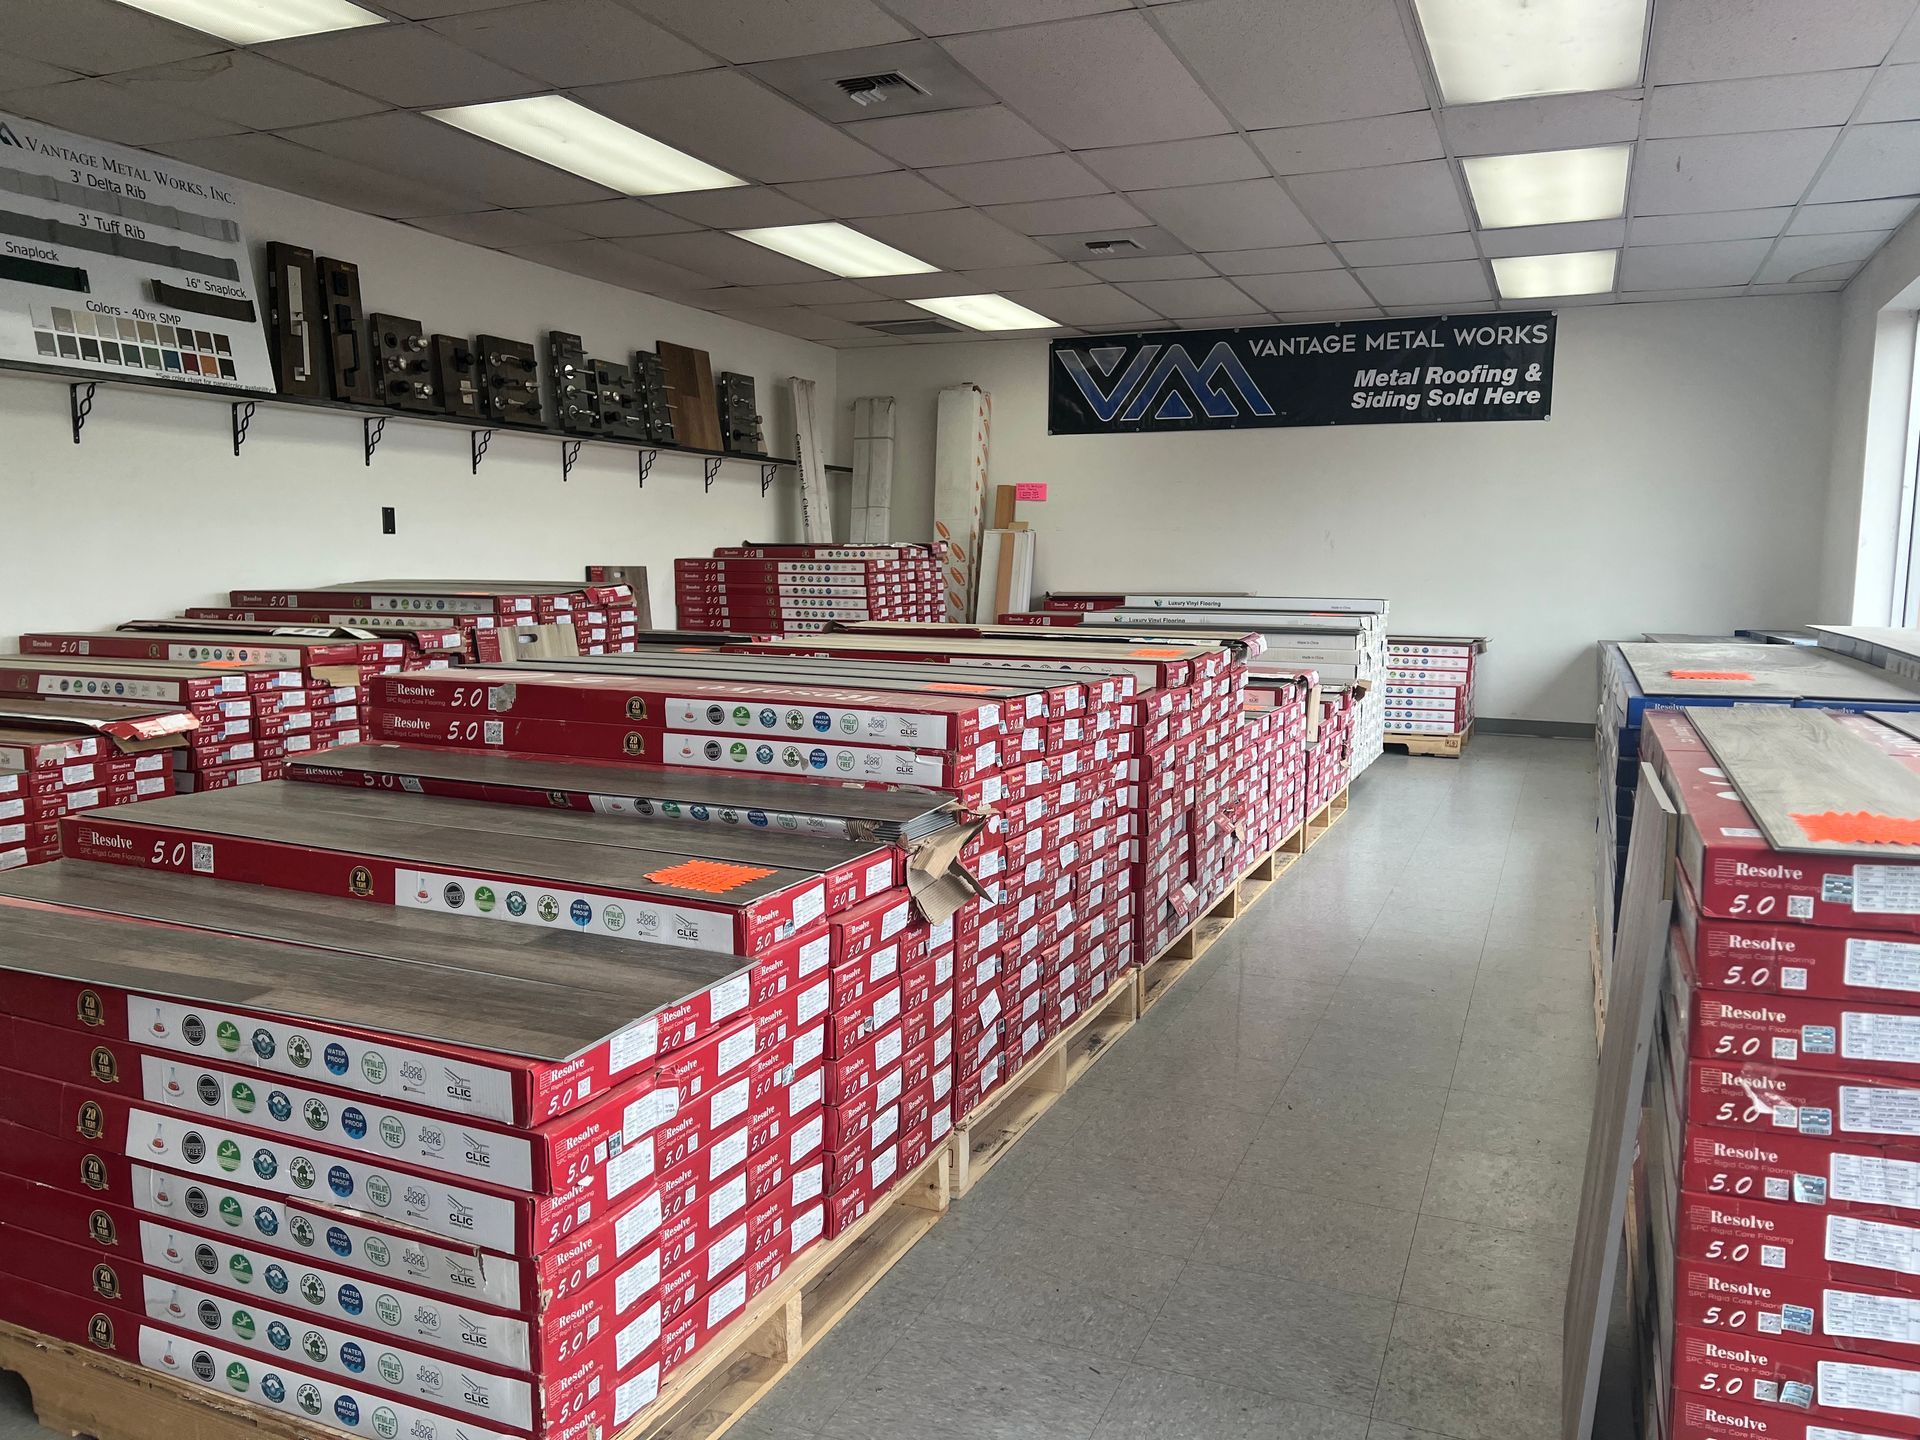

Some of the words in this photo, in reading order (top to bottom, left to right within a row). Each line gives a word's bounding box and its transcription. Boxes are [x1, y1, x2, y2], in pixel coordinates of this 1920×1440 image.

[25, 136, 97, 167] VANTAGE
[103, 156, 150, 182] METAL
[70, 170, 82, 182] 3'
[88, 172, 121, 194] Delta
[126, 183, 146, 199] Rib
[79, 214, 90, 227] 3'
[94, 217, 120, 234] Tuff
[125, 224, 145, 239] Rib
[5, 241, 59, 262] Snaplock
[185, 277, 201, 288] 16"
[204, 281, 246, 298] Snaplock
[86, 300, 121, 316] Colors
[160, 312, 181, 324] SMP
[1249, 334, 1356, 357] VANTAGE
[1366, 329, 1444, 351] METAL
[1453, 324, 1548, 346] WORKS
[1354, 366, 1420, 388] Metal
[1425, 364, 1518, 386] Roofing
[1524, 363, 1543, 382] &
[1351, 391, 1422, 411] Siding
[1427, 388, 1480, 407] Sold
[1483, 387, 1541, 405] Here
[803, 498, 811, 528] Choice
[60, 642, 76, 653] 5.0
[397, 683, 434, 696] Resolve
[451, 688, 482, 707] 5.0
[394, 716, 430, 729] Resolve
[447, 721, 478, 740] 5.0
[112, 774, 124, 782] 5.0
[42, 810, 55, 818] 5.0
[92, 832, 132, 849] Resolve
[151, 841, 185, 865] 5.0
[355, 871, 366, 881] 20
[1736, 862, 1802, 880] Resolve
[1729, 894, 1776, 915] 5.0
[608, 918, 620, 927] FREE
[756, 909, 779, 925] Resolve
[677, 929, 698, 938] CLIC
[755, 934, 771, 951] 5.0
[1729, 935, 1796, 951] Resolve
[761, 959, 784, 976] Resolve
[1723, 966, 1769, 986] 5.0
[85, 996, 94, 1008] 20
[759, 983, 774, 1002] 5.0
[663, 1004, 691, 1023] Resolve
[1720, 1004, 1786, 1022] Resolve
[1745, 1024, 1766, 1032] Core
[660, 1031, 681, 1053] 5.0
[1715, 1036, 1760, 1056] 5.0
[98, 1053, 108, 1065] 20
[327, 1048, 346, 1057] WATER
[327, 1055, 345, 1064] PROOF
[403, 1061, 422, 1074] floor
[551, 1058, 585, 1082] Resolve
[758, 1054, 779, 1072] Resolve
[367, 1068, 382, 1080] FREE
[400, 1069, 423, 1080] score
[1721, 1072, 1786, 1090] Resolve
[447, 1086, 471, 1098] CLIC
[755, 1078, 771, 1099] 5.0
[548, 1088, 572, 1115] 5.0
[1716, 1103, 1760, 1123] 5.0
[422, 1126, 442, 1138] floor
[566, 1122, 600, 1150] Resolve
[666, 1116, 693, 1139] Resolve
[418, 1134, 441, 1146] score
[466, 1152, 490, 1164] CLIC
[664, 1144, 683, 1169] 5.0
[1714, 1143, 1778, 1163] Resolve
[567, 1154, 589, 1184] 5.0
[1708, 1174, 1752, 1194] 5.0
[1711, 1210, 1774, 1230] Resolve
[1691, 1224, 1708, 1232] SPC
[1711, 1227, 1732, 1235] Rigid
[1735, 1230, 1755, 1239] Core
[1758, 1233, 1794, 1244] Flooring
[556, 1238, 593, 1266] Resolve
[1706, 1241, 1749, 1262] 5.0
[557, 1269, 581, 1299] 5.0
[1708, 1277, 1771, 1298] Resolve
[559, 1300, 594, 1328] Resolve
[1702, 1307, 1746, 1328] 5.0
[462, 1333, 486, 1345] CLIC
[666, 1318, 692, 1344] Resolve
[558, 1331, 583, 1362] 5.0
[1706, 1343, 1768, 1366] Resolve
[663, 1347, 681, 1373] 5.0
[1700, 1373, 1743, 1394] 5.0
[1705, 1409, 1767, 1431] Resolve
